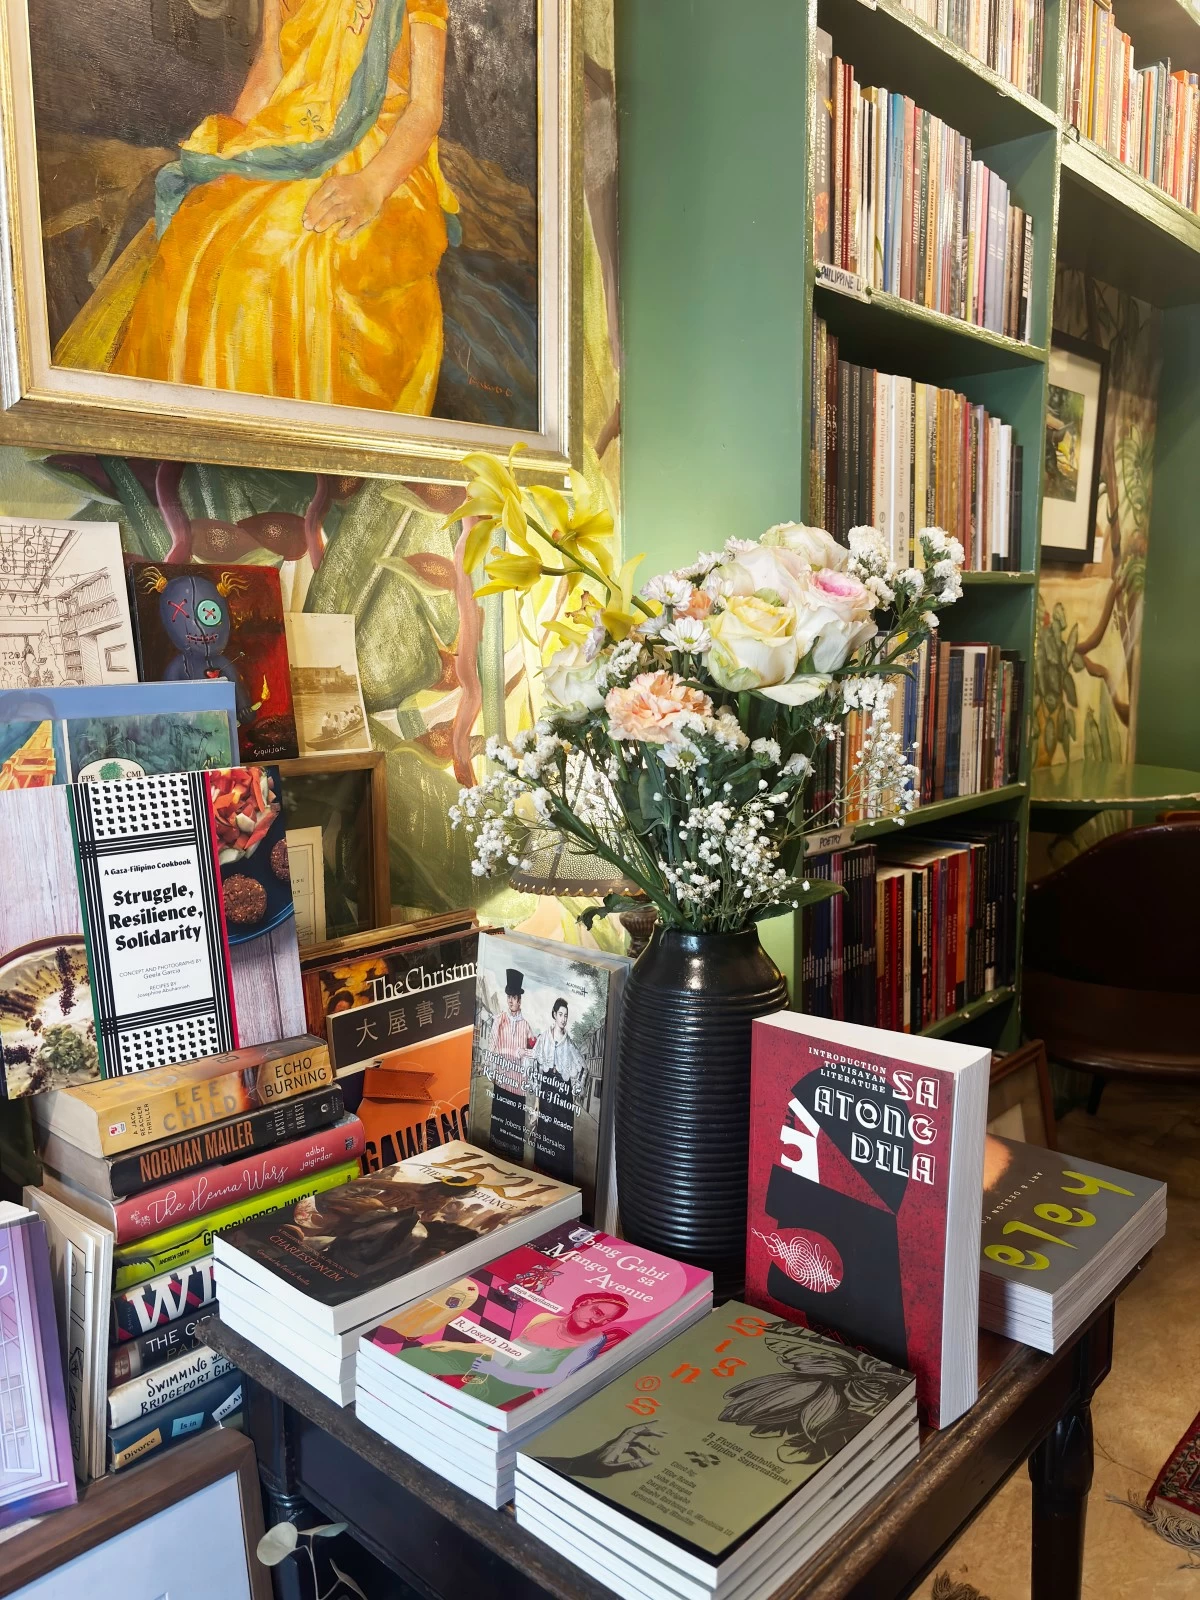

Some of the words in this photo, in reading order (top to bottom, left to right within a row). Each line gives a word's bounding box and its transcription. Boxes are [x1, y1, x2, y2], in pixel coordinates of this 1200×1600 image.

[821, 265, 854, 289] PHILIPPINE
[81, 774, 95, 782] FPE
[126, 770, 142, 779] CMI
[819, 833, 842, 848] POETRY
[157, 859, 191, 869] Cookbook
[113, 883, 194, 906] Struggle,
[108, 905, 203, 930] Resilience,
[116, 924, 201, 952] Solidarity
[119, 969, 144, 977] CONCEPT
[157, 960, 194, 970] PHOTOGRAPHS
[367, 978, 403, 1002] The
[406, 960, 479, 994] Christm
[356, 990, 462, 1047] 大屋書房
[275, 1057, 312, 1079] ECHO
[483, 1050, 524, 1073] Philippine
[527, 1067, 569, 1095] Genealogy
[572, 1085, 581, 1095] &
[808, 1046, 887, 1074] INTRODUCTION
[824, 1061, 837, 1070] TO
[840, 1064, 886, 1084] VISAYAN
[175, 1080, 220, 1107] LEE
[264, 1068, 327, 1098] BURNING
[483, 1066, 519, 1088] Religious
[521, 1082, 529, 1091] &
[547, 1091, 581, 1116] History
[820, 1069, 886, 1094] LITERATURE
[892, 1069, 940, 1109] SA
[144, 1103, 152, 1135] THRILLER
[163, 1095, 236, 1131] CHILD
[274, 1109, 286, 1136] CASTLE
[486, 1089, 495, 1098] The
[497, 1094, 516, 1108] Luciano
[553, 1116, 573, 1132] Reader
[814, 1085, 937, 1145] ATONG
[139, 1140, 202, 1182] NORMAN
[205, 1121, 254, 1161] MAILER
[300, 1153, 333, 1171] jaigirdar
[306, 1146, 325, 1158] adiba
[851, 1131, 936, 1185] DILA
[420, 1166, 441, 1178] THE
[148, 1199, 186, 1224] The
[189, 1178, 243, 1212] Henna
[243, 1162, 290, 1190] Wars
[992, 1191, 1021, 1213] DESIGN
[159, 1254, 177, 1266] ANDREW
[177, 1249, 190, 1260] SMITH
[544, 1242, 609, 1275] Mango
[568, 1227, 622, 1260] Ubang
[616, 1254, 670, 1282] Gabii
[584, 1272, 655, 1304] Avenue
[637, 1275, 654, 1287] sa
[146, 1329, 179, 1353] THE
[464, 1323, 496, 1348] Joseph
[498, 1339, 523, 1358] Dazo
[147, 1358, 208, 1398] SWIMMING
[140, 1370, 212, 1416] BRIDGEPORT
[219, 1403, 231, 1416] the
[189, 1419, 197, 1428] in
[123, 1437, 156, 1461] Divorce
[717, 1437, 743, 1453] Fiction
[744, 1450, 785, 1474] Anthology
[707, 1440, 737, 1459] Filipino
[738, 1456, 792, 1486] Supernatural
